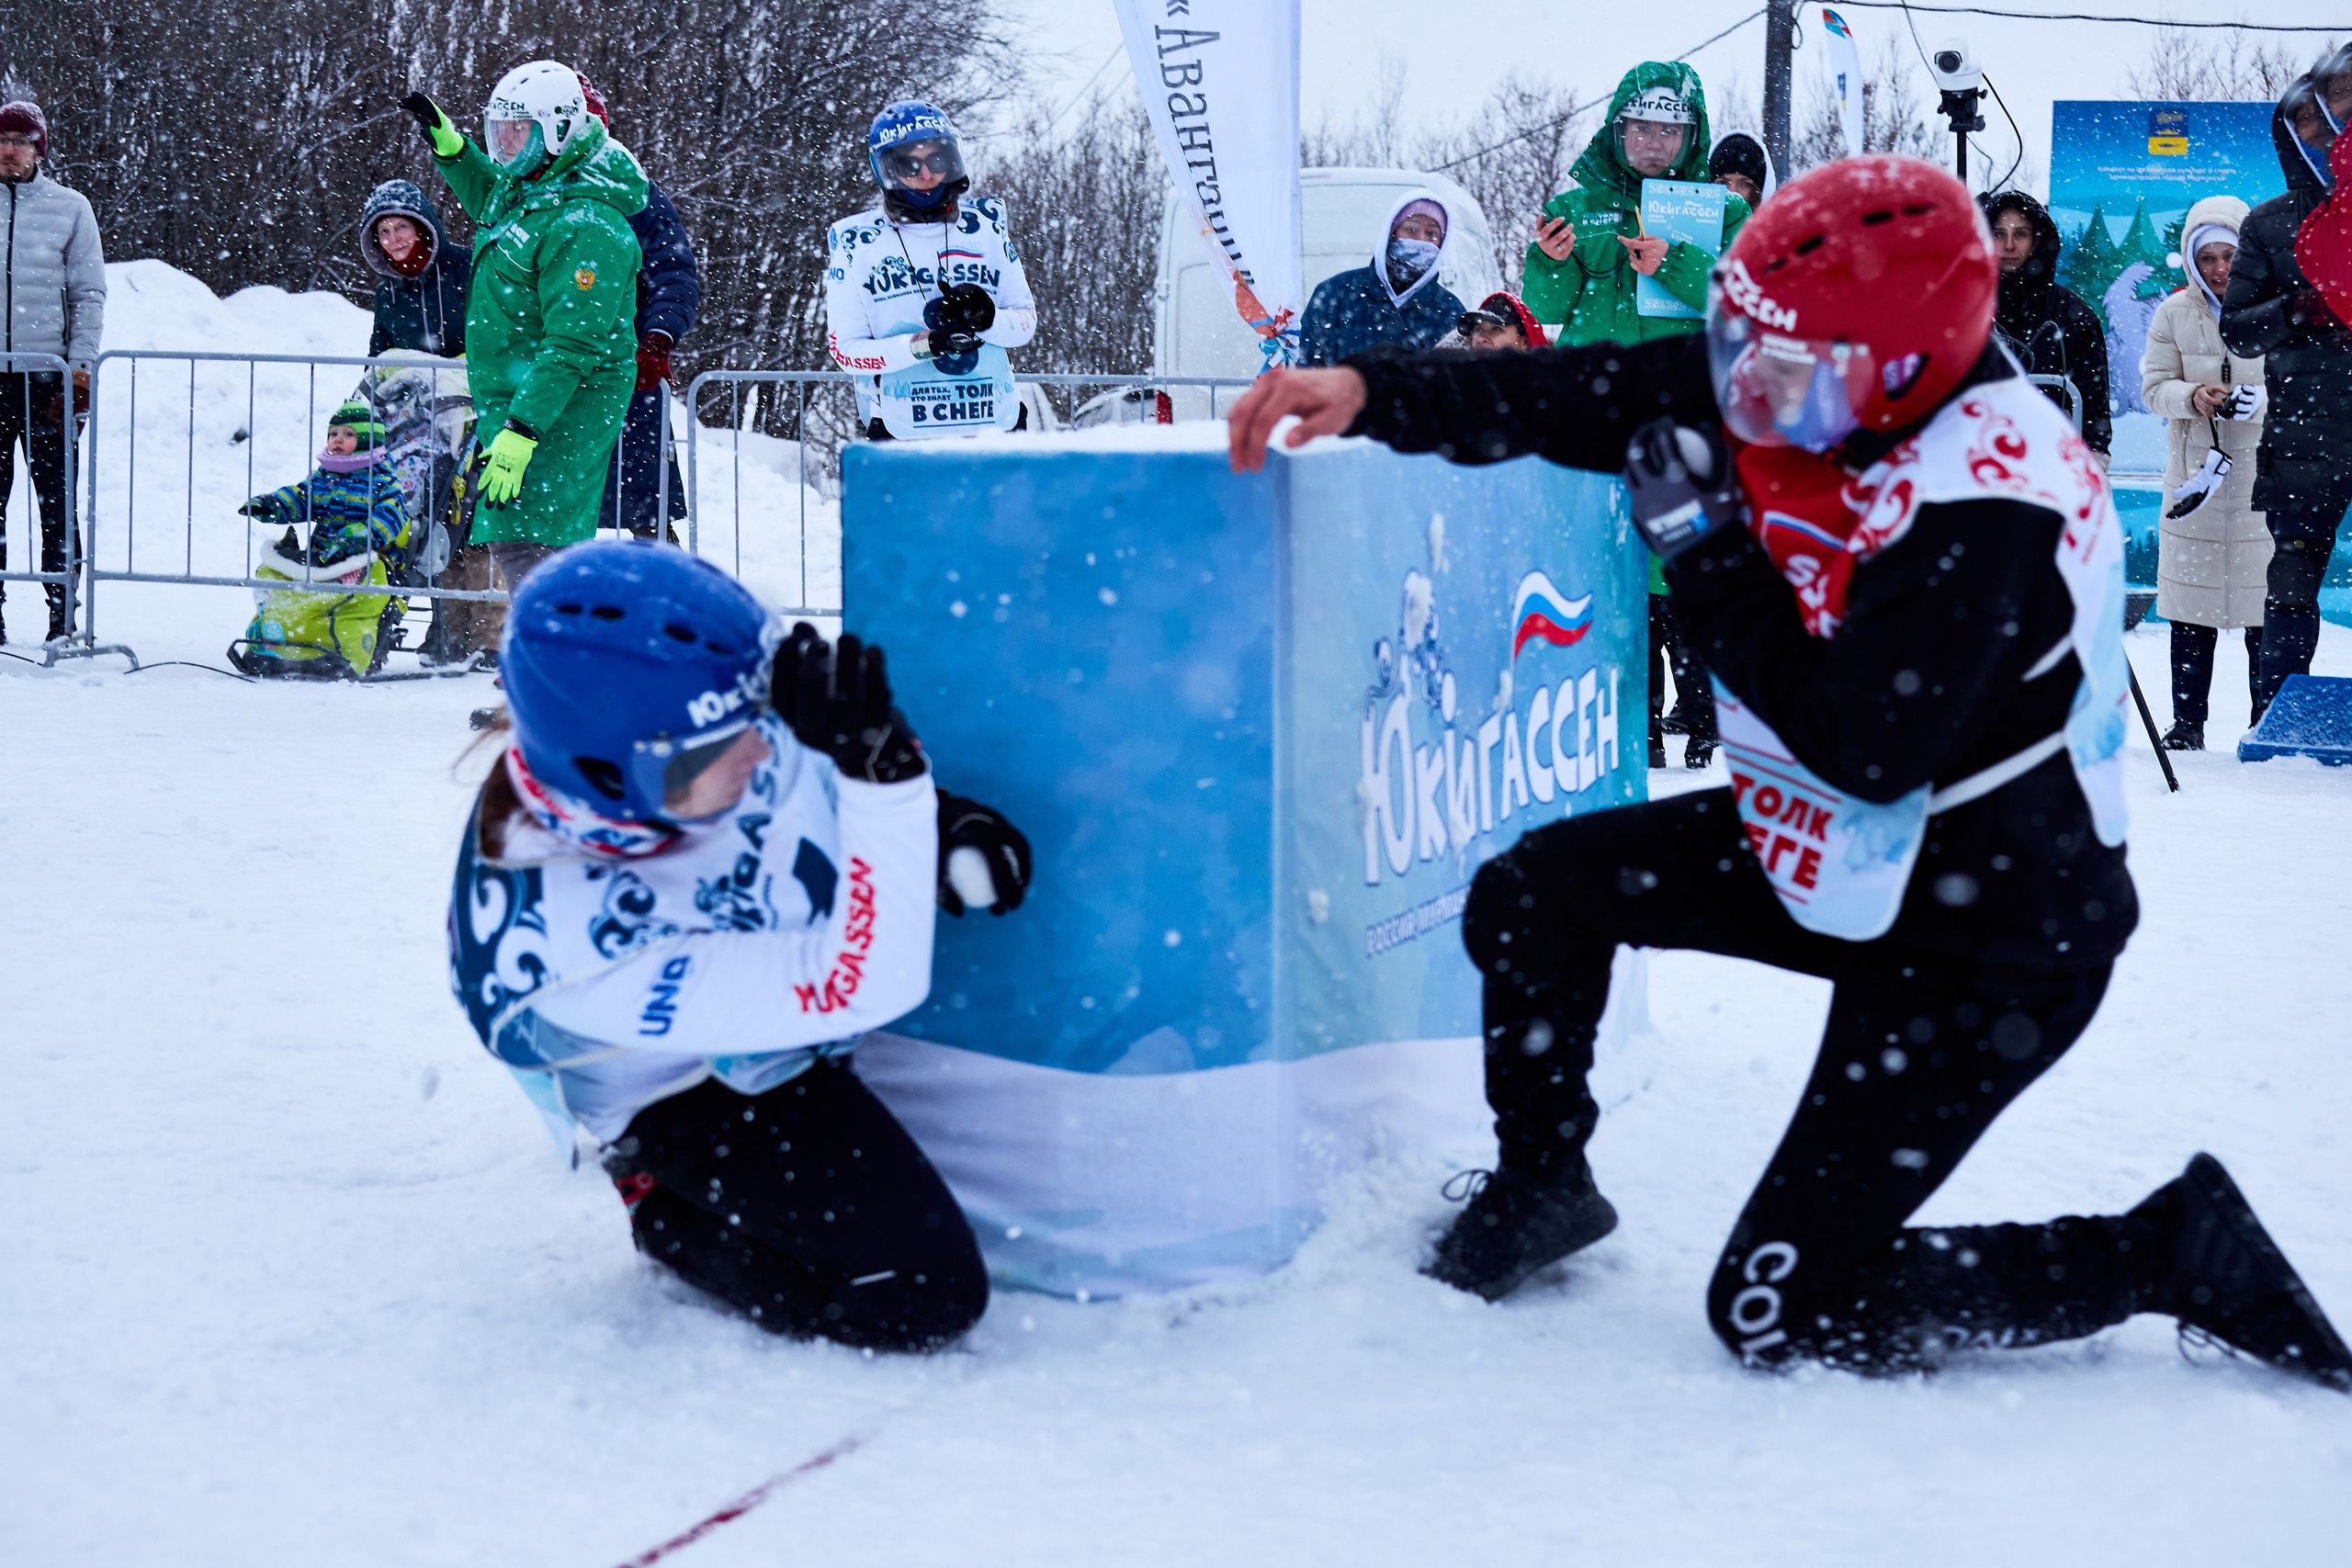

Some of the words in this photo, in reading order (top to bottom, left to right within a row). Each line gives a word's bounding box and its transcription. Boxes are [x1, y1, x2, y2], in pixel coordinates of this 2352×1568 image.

[863, 263, 1001, 296] YUKIGASSEN
[956, 383, 993, 400] ТОЛК
[912, 404, 928, 423] В
[933, 400, 994, 422] СНЕГЕ
[1361, 669, 1620, 887] ЮКИГАССЕН
[1731, 772, 1834, 842] ТОЛК
